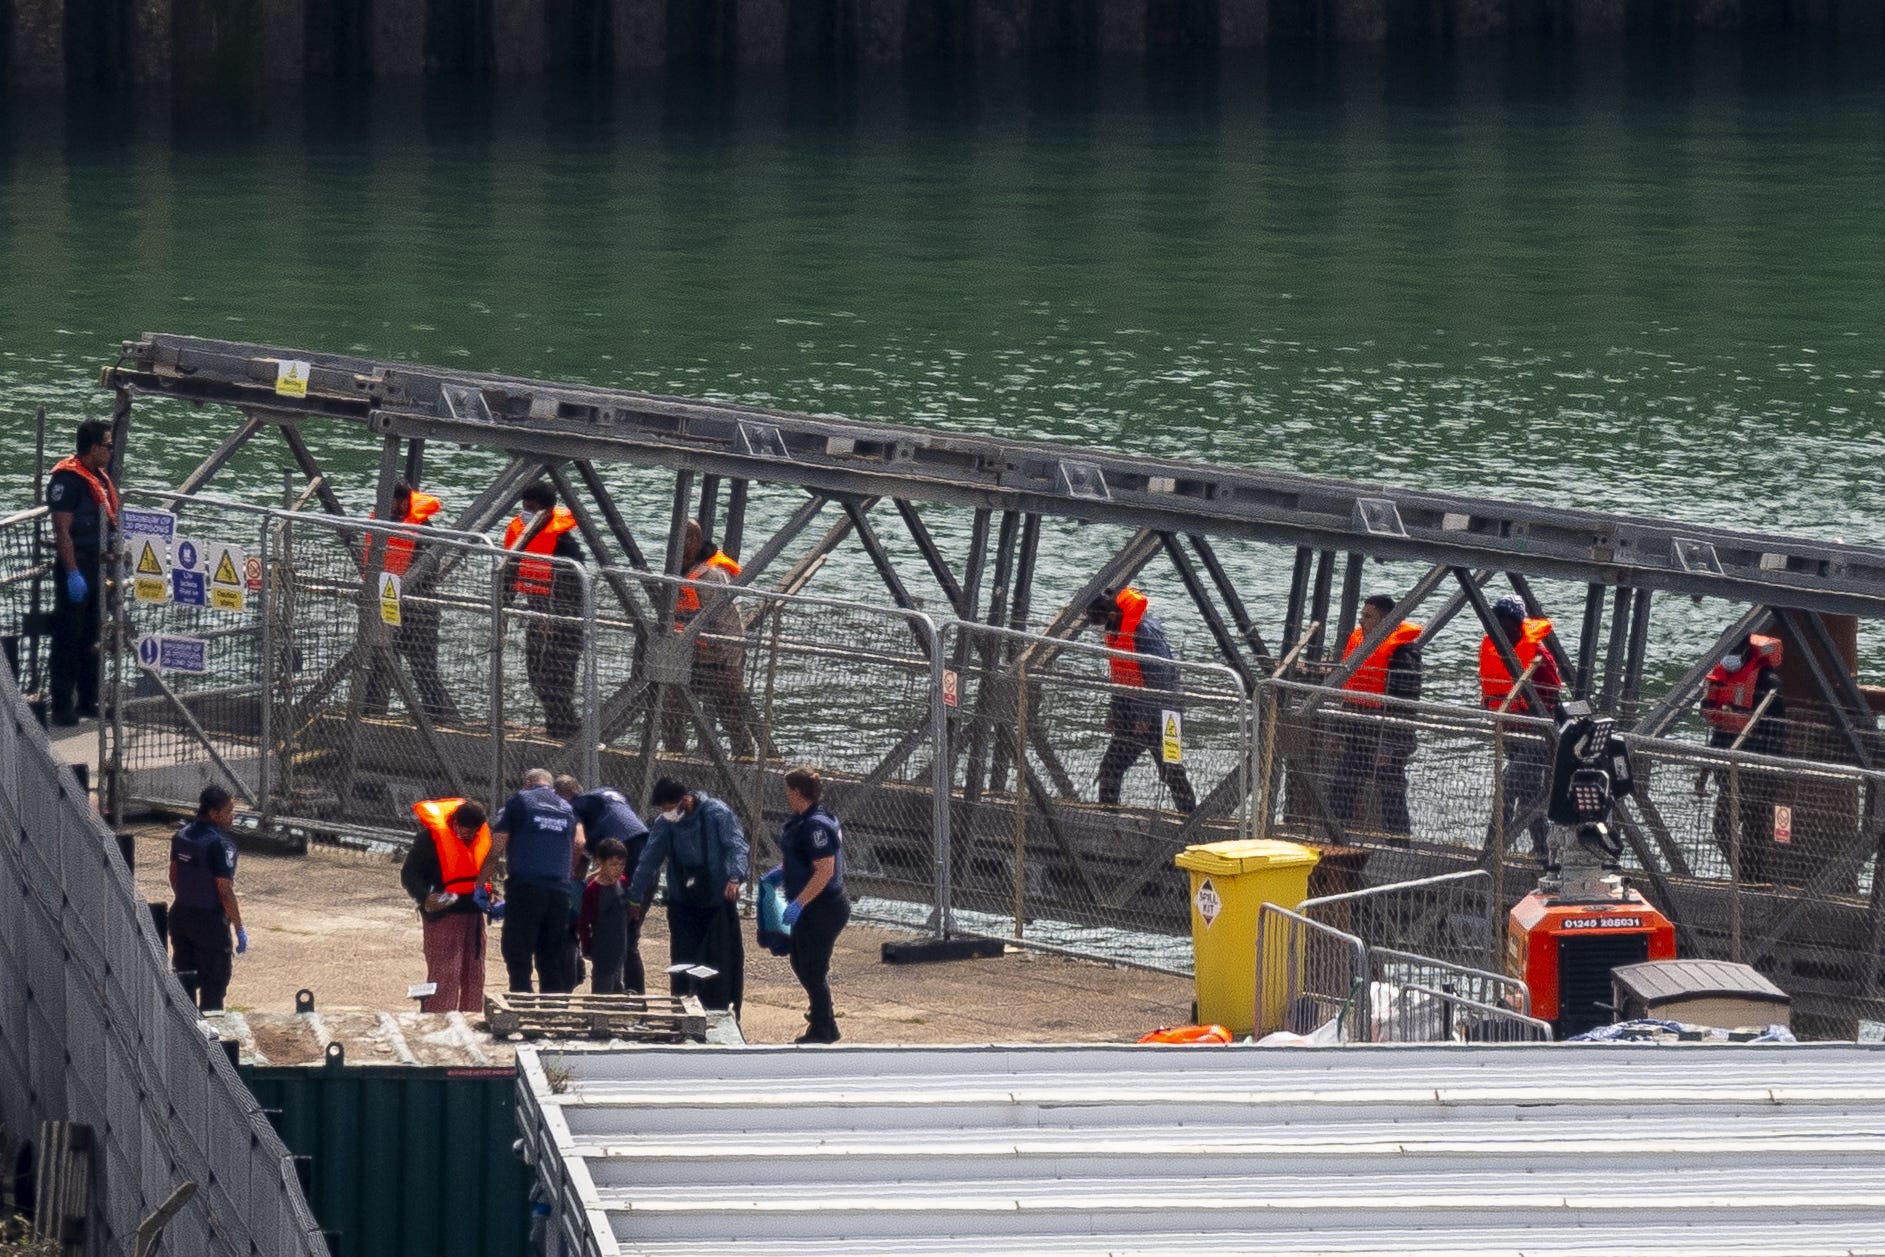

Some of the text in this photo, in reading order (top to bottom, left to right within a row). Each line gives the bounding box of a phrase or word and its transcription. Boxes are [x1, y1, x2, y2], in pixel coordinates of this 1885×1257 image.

[134, 523, 170, 533] PERSONS
[1199, 891, 1218, 905] SPILL
[1203, 904, 1214, 914] KIT
